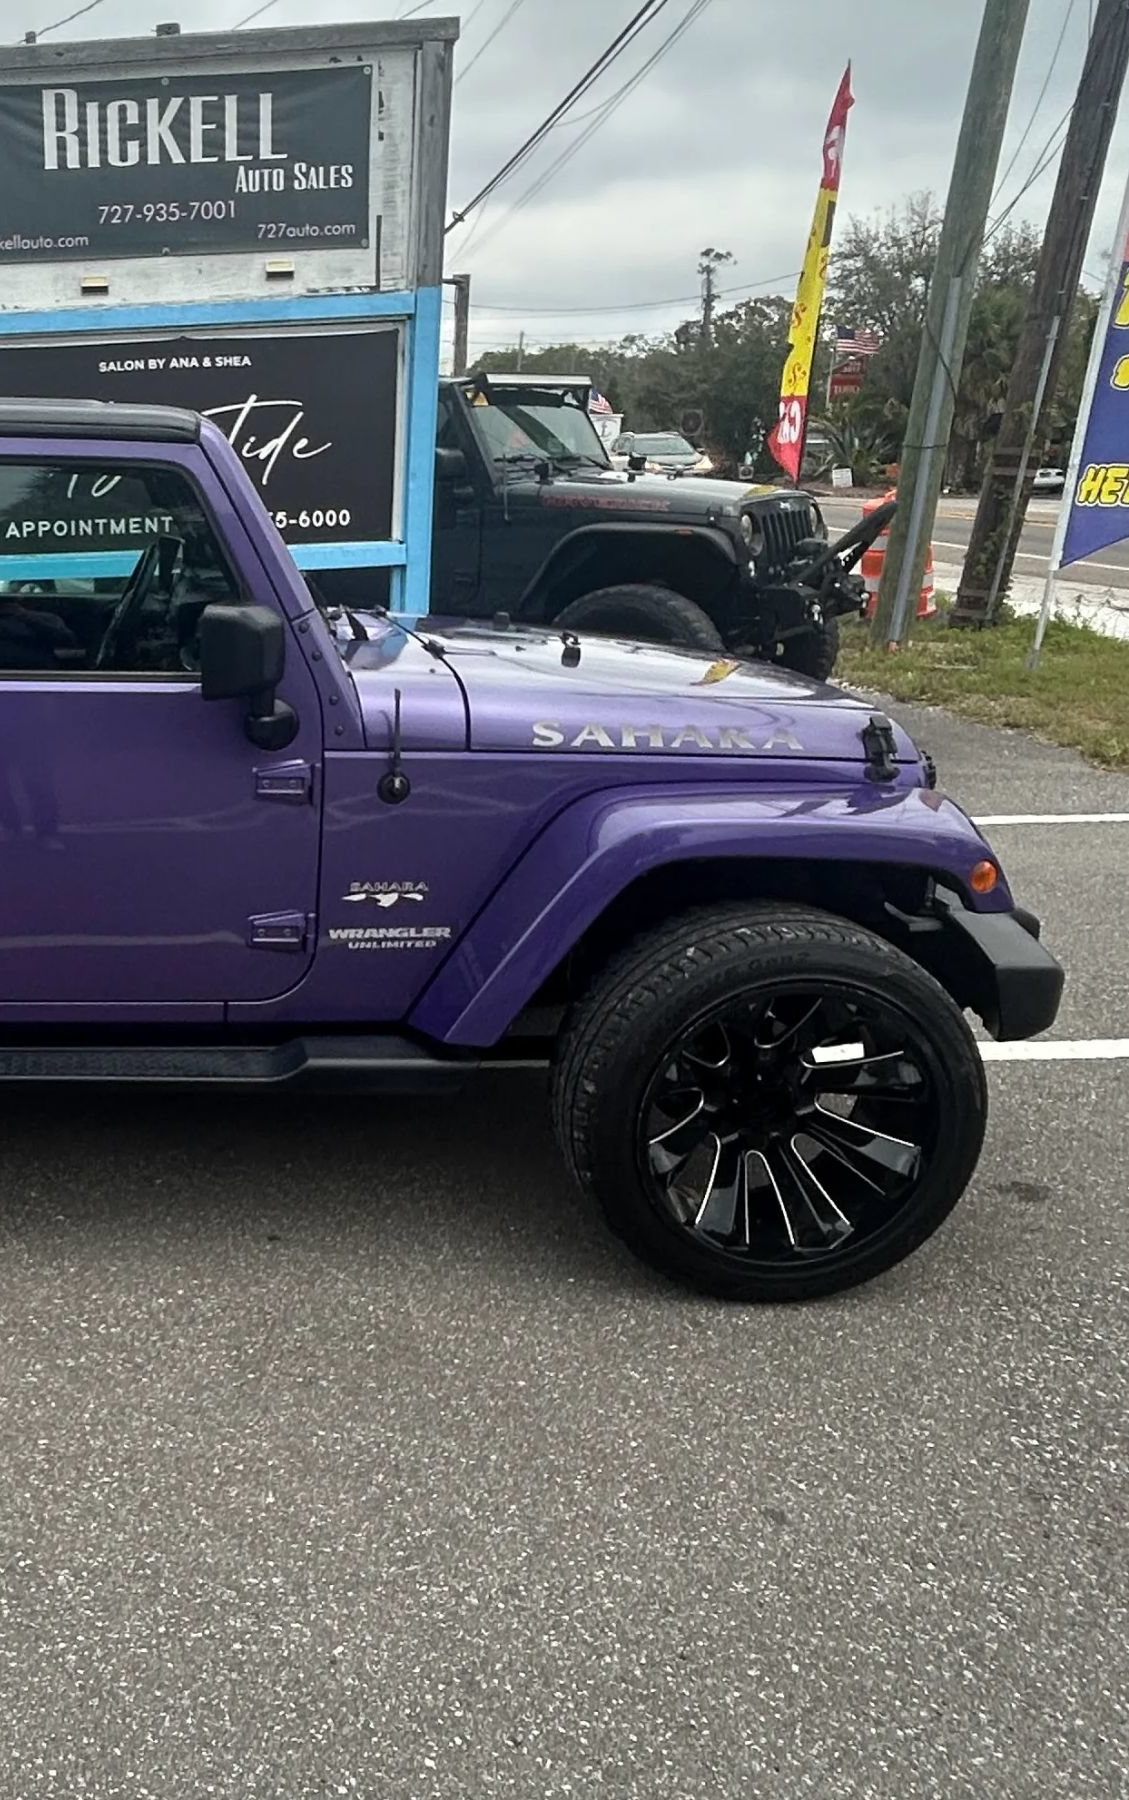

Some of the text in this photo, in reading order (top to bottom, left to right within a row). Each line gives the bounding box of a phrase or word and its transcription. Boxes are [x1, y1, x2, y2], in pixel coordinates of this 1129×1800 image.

[98, 200, 236, 224] 727-935-7001
[257, 222, 356, 239] 727auto.com
[99, 355, 252, 372] SALON BY ANA & SHEA
[201, 394, 333, 485] Tide
[1076, 464, 1129, 504] HE
[5, 516, 174, 539] APPOINTMENT
[532, 720, 804, 750] SAHARA
[349, 881, 429, 892] SAHARA
[328, 927, 451, 939] WRANGLER
[348, 940, 436, 949] UNLIMITED
